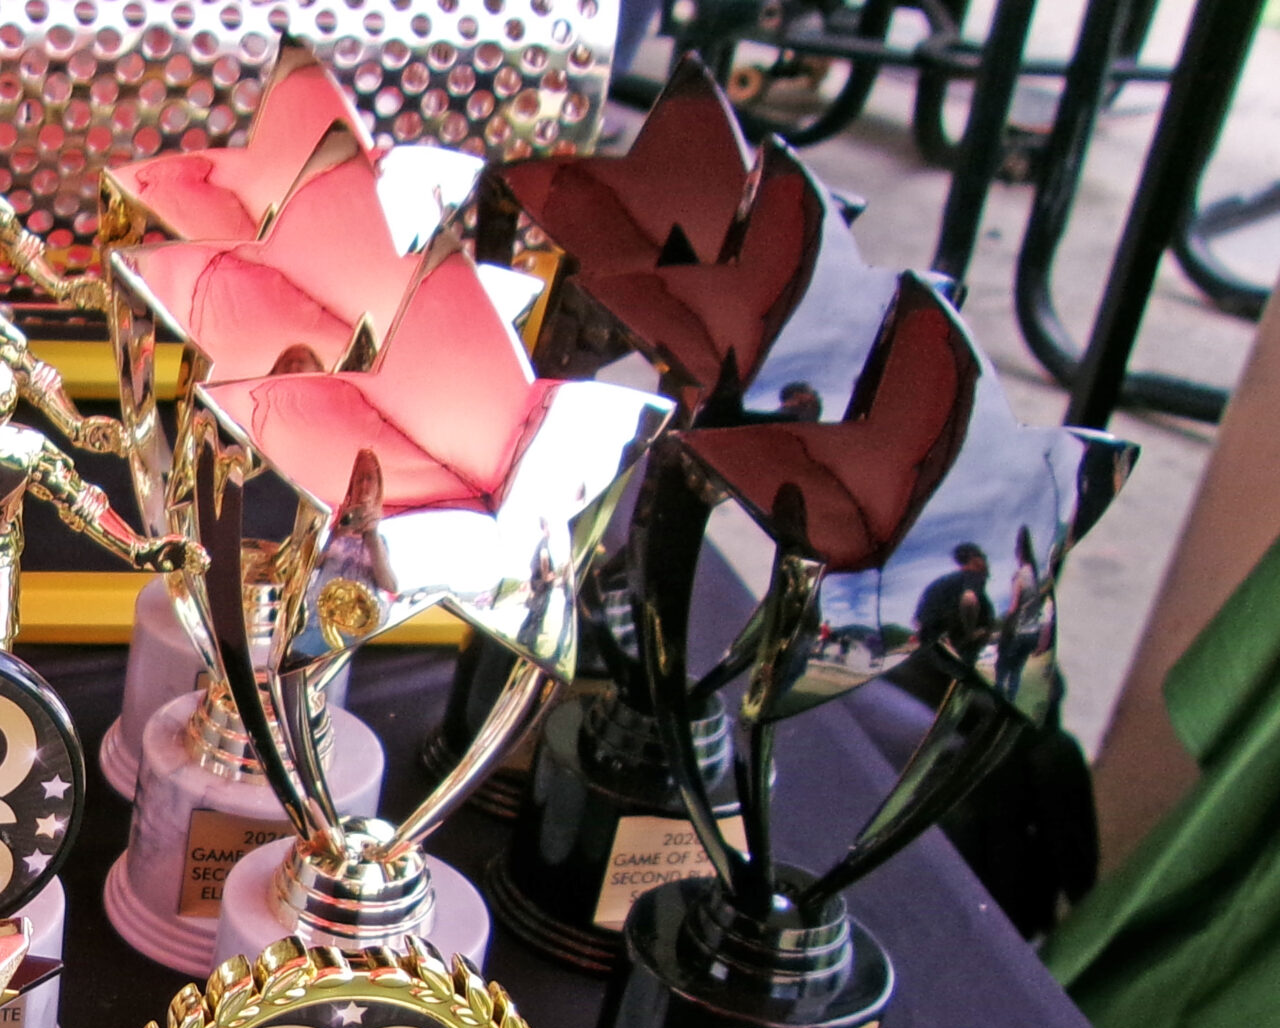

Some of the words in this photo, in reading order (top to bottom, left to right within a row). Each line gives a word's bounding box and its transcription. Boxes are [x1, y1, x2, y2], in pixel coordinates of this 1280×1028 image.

[243, 831, 289, 845] 202
[614, 852, 661, 866] GAME
[666, 851, 690, 865] OF
